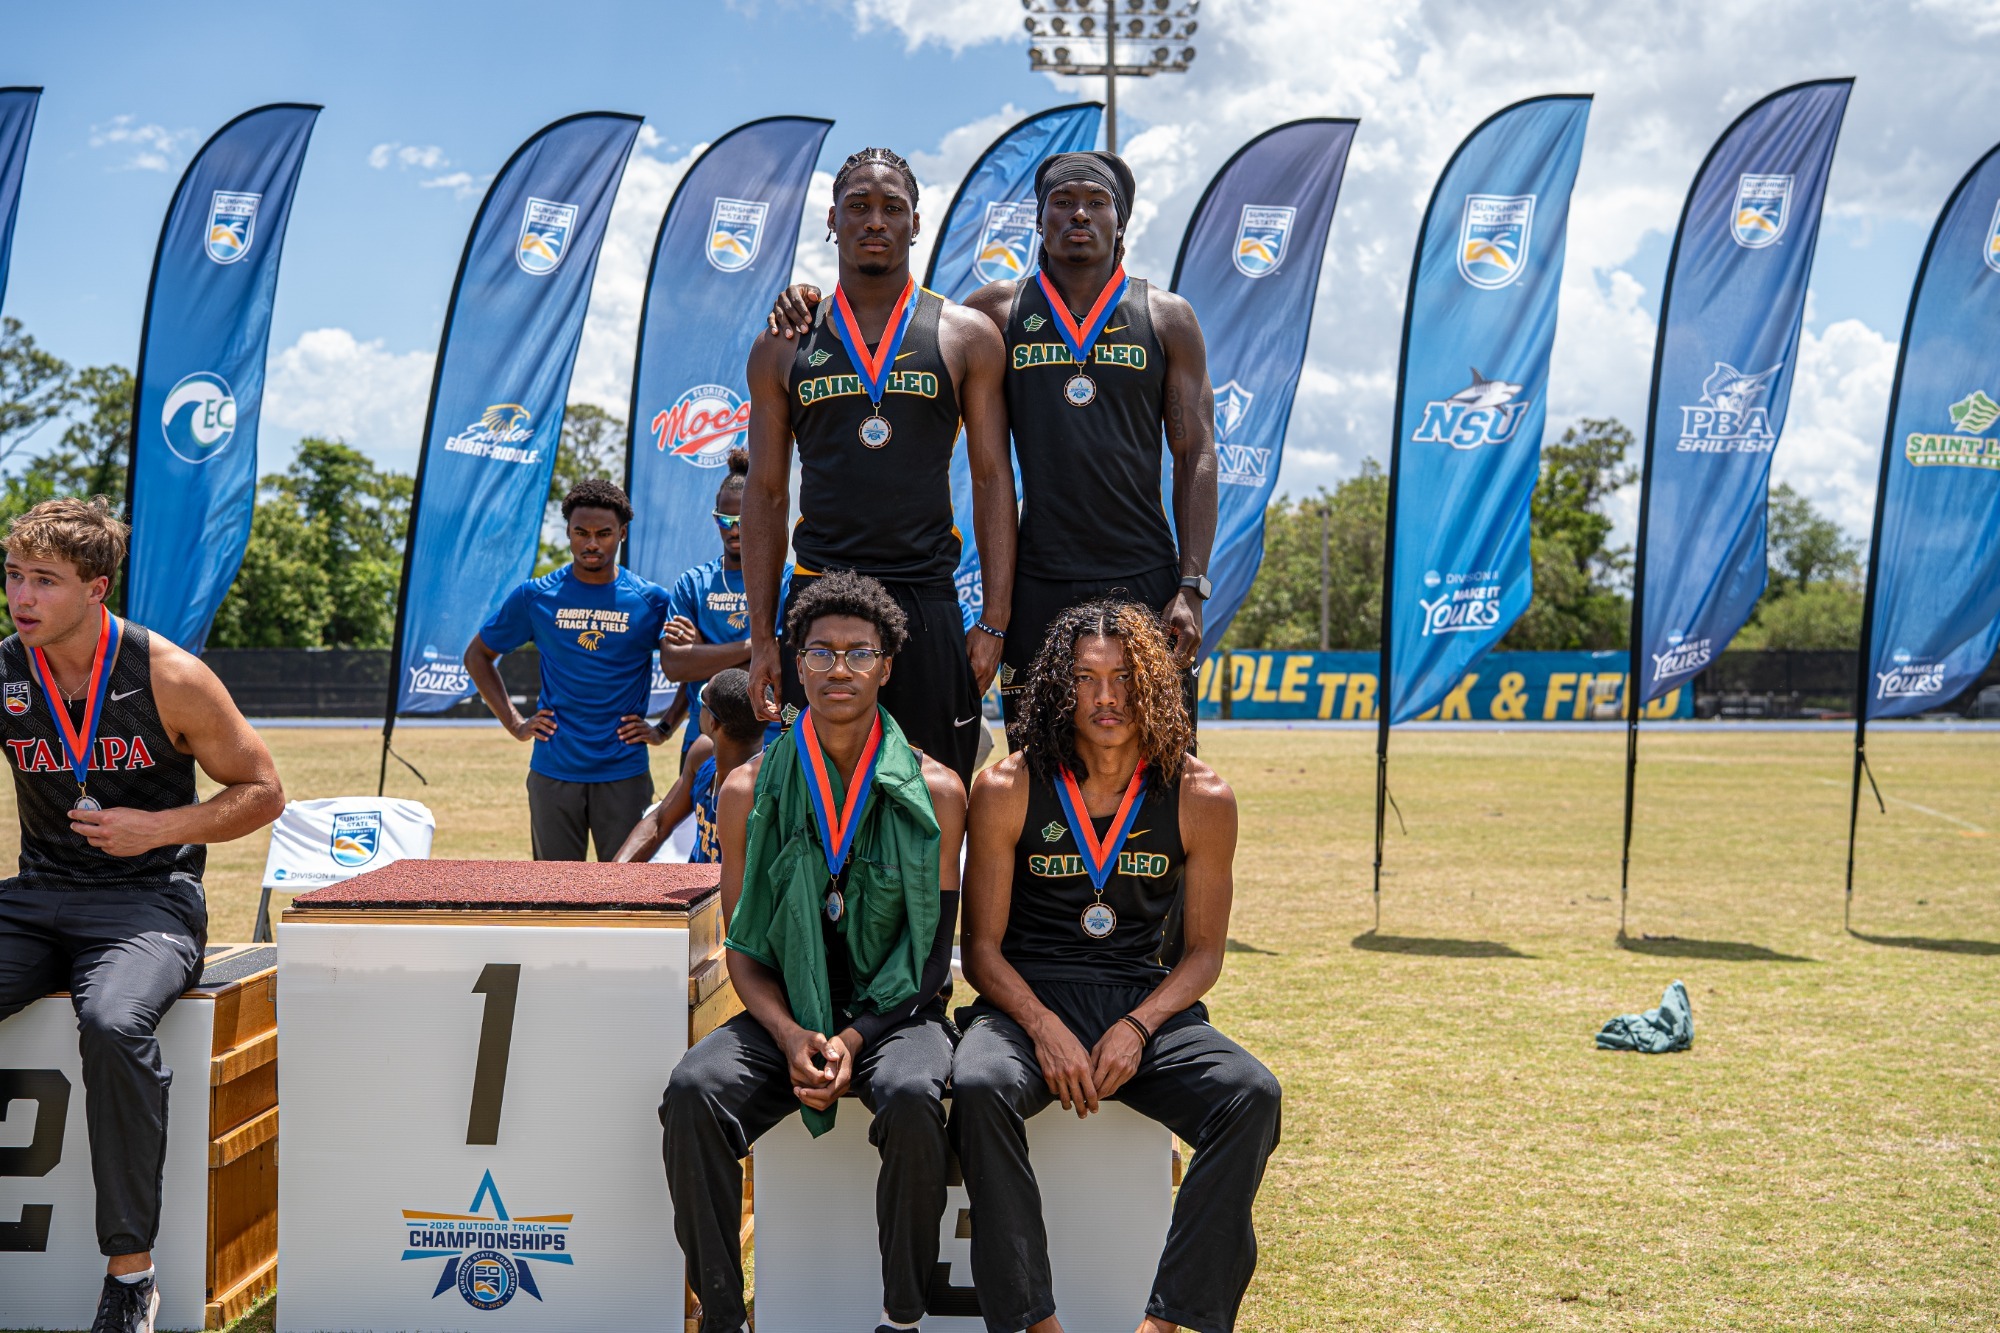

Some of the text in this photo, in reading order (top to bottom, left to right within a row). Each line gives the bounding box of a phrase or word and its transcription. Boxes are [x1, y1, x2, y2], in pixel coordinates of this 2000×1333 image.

[720, 204, 761, 215] SUNSHINE
[1473, 202, 1526, 213] SUNSHINE
[726, 213, 751, 222] STATE
[1483, 213, 1514, 222] STATE
[1013, 343, 1147, 371] SAIN LEO
[693, 387, 730, 400] FLORIDA
[798, 371, 939, 407] SAIN LEO
[203, 398, 235, 429] EC
[1410, 401, 1530, 450] NSU
[1679, 405, 1777, 439] PBA
[444, 436, 539, 464] EMBRY-RIDDLE
[1676, 439, 1775, 453] SAILFISH
[1906, 432, 1983, 456] SAINT
[1214, 442, 1272, 477] NN
[1446, 571, 1491, 584] DIVISION
[1452, 586, 1501, 602] MAKE IT
[708, 602, 746, 612] TRACK &
[556, 608, 630, 623] EMBRY-RIDDLE
[558, 619, 627, 633] TRACK & FIELD
[430, 663, 460, 674] MAKE
[1902, 664, 1933, 675] MAKE
[7, 683, 28, 694] SSC
[1489, 671, 1529, 720] &
[338, 814, 380, 823] SUNSHINE
[1118, 851, 1169, 879] LEO
[290, 871, 329, 880] DIVISION
[466, 963, 521, 1145] 1
[429, 1221, 546, 1232] 2026 OUTDOOR TRACK
[409, 1230, 566, 1251] CHAMPIONSHIPS
[460, 1252, 516, 1296] SUNSHINE STATE CONFERENCE
[475, 1266, 500, 1276] 50
